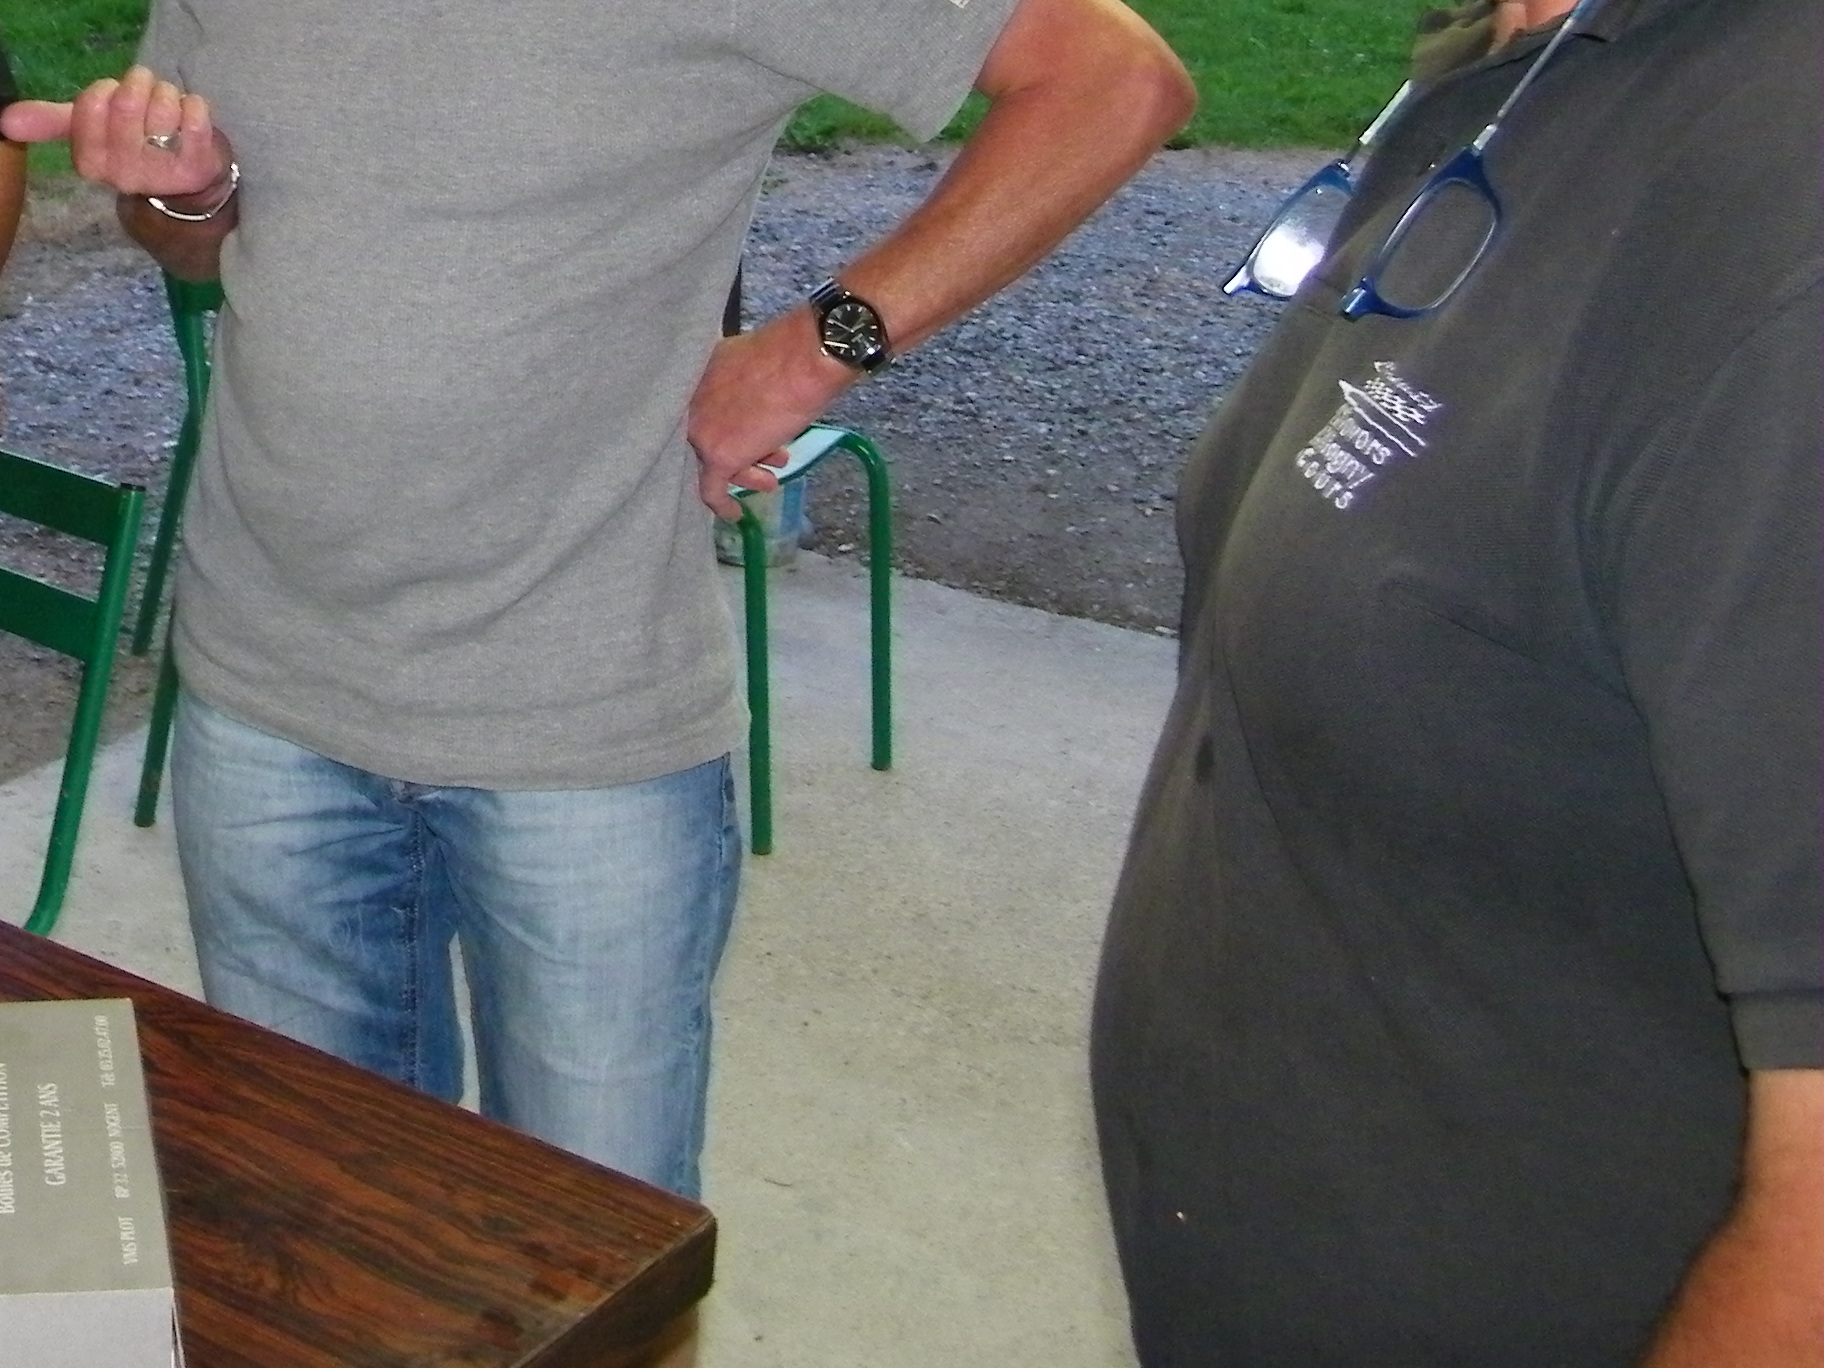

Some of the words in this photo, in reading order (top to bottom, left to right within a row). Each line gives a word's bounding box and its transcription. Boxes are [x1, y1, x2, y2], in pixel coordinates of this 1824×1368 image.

[37, 1082, 60, 1107] ANS
[39, 1109, 60, 1118] 2
[40, 1121, 66, 1186] GARANTIE
